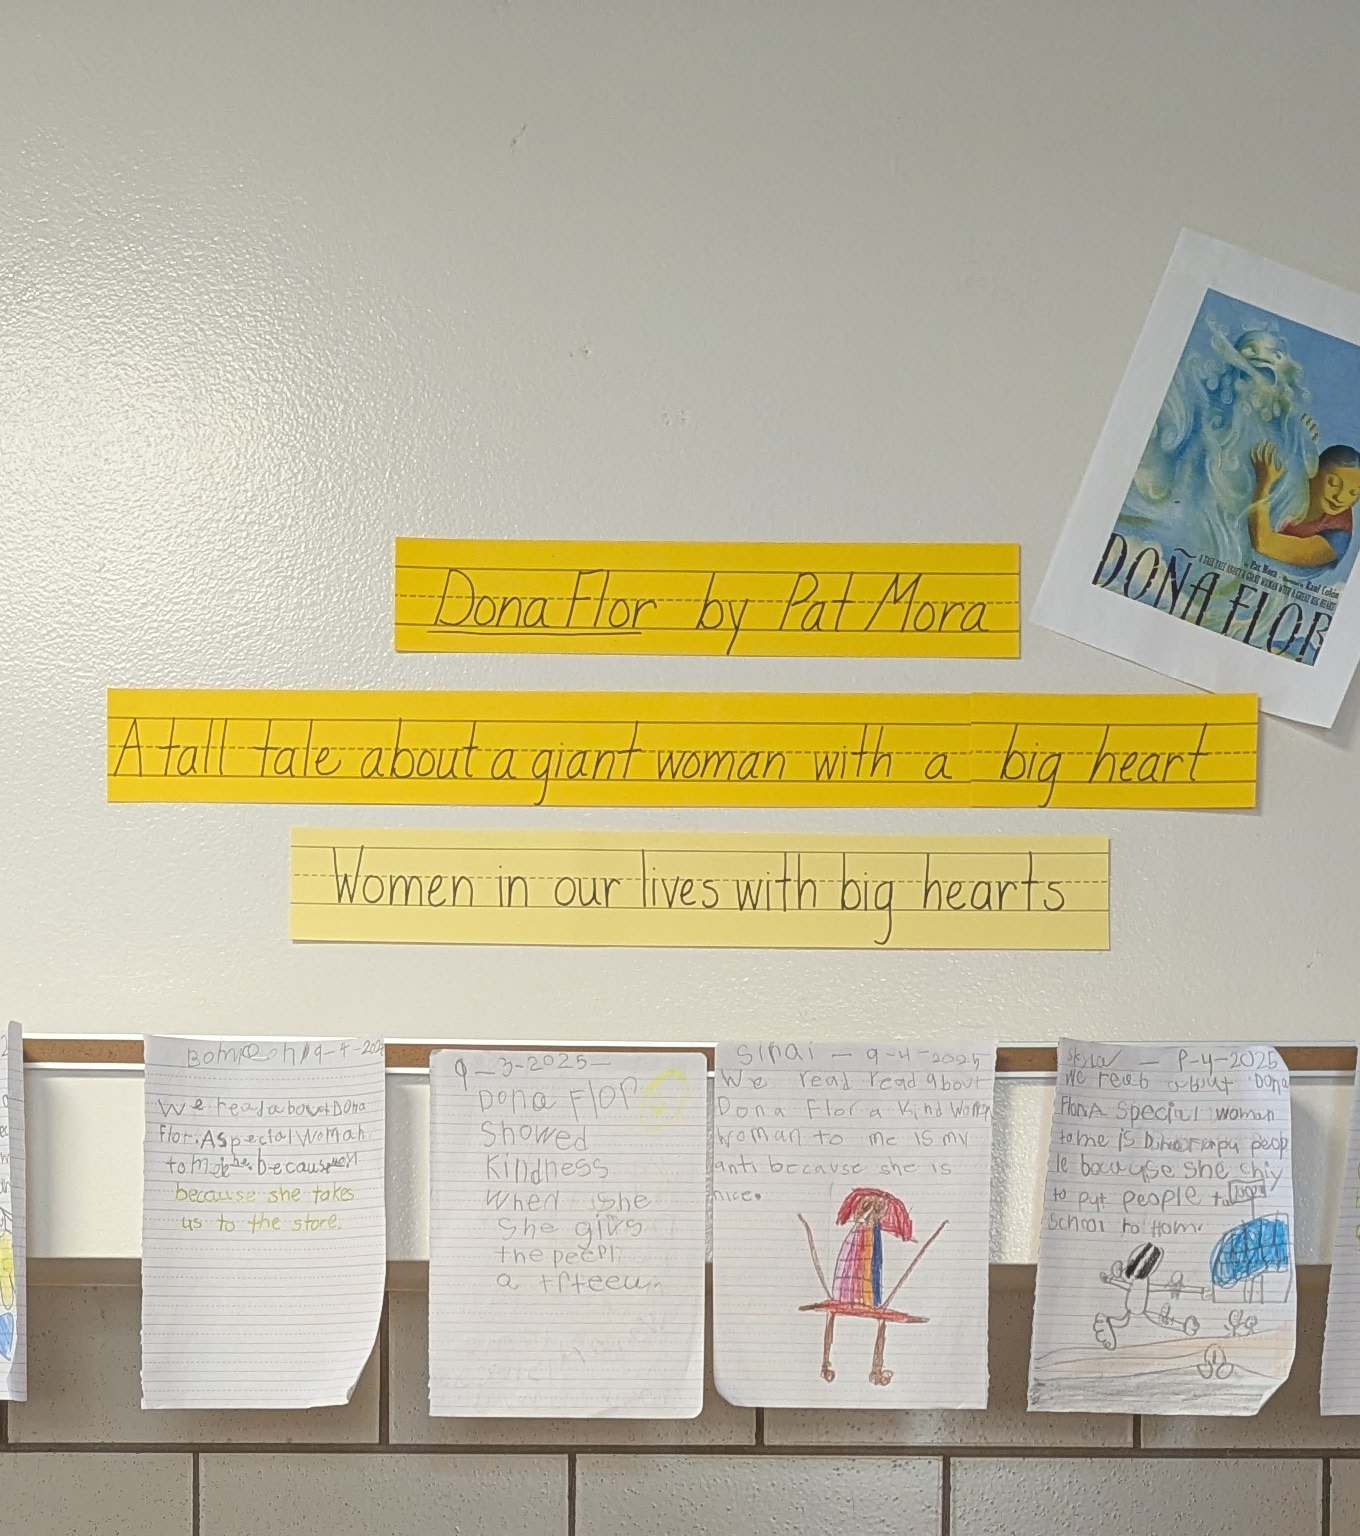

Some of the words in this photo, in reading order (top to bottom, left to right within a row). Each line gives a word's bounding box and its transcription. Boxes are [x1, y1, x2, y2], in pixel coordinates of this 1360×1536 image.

[1092, 532, 1220, 626] DOÑA
[1220, 583, 1332, 667] FLOR
[434, 569, 549, 628] Dona
[566, 569, 660, 629] Flor
[697, 572, 752, 655] by
[779, 572, 854, 632] Pat
[864, 573, 990, 633] Mora
[114, 718, 142, 777] A
[159, 718, 228, 776] tall
[253, 720, 342, 778] tale
[360, 718, 478, 779] about
[491, 748, 517, 779] a
[532, 720, 643, 807] giant
[657, 751, 786, 781] woman
[813, 724, 891, 781] with
[924, 753, 952, 780] a
[1000, 723, 1058, 808] big
[1088, 723, 1209, 785] heart
[332, 845, 473, 907] Women
[498, 865, 528, 907] in
[556, 875, 623, 908] our
[641, 849, 718, 908] lives
[735, 851, 818, 911] with
[842, 851, 894, 945] big
[923, 850, 1065, 911] hearts
[718, 1097, 784, 1119] Dona
[807, 1099, 861, 1119] Flor
[870, 1107, 882, 1119] a
[814, 1130, 843, 1145] to
[869, 1133, 897, 1146] me
[943, 1133, 968, 1148] my
[769, 1155, 867, 1174] because
[881, 1158, 917, 1176] she
[176, 1182, 256, 1202] because
[268, 1187, 300, 1202] she
[313, 1181, 354, 1204] takes
[182, 1218, 202, 1231] us
[218, 1214, 235, 1232] to
[250, 1212, 280, 1233] the
[495, 1246, 543, 1263] the
